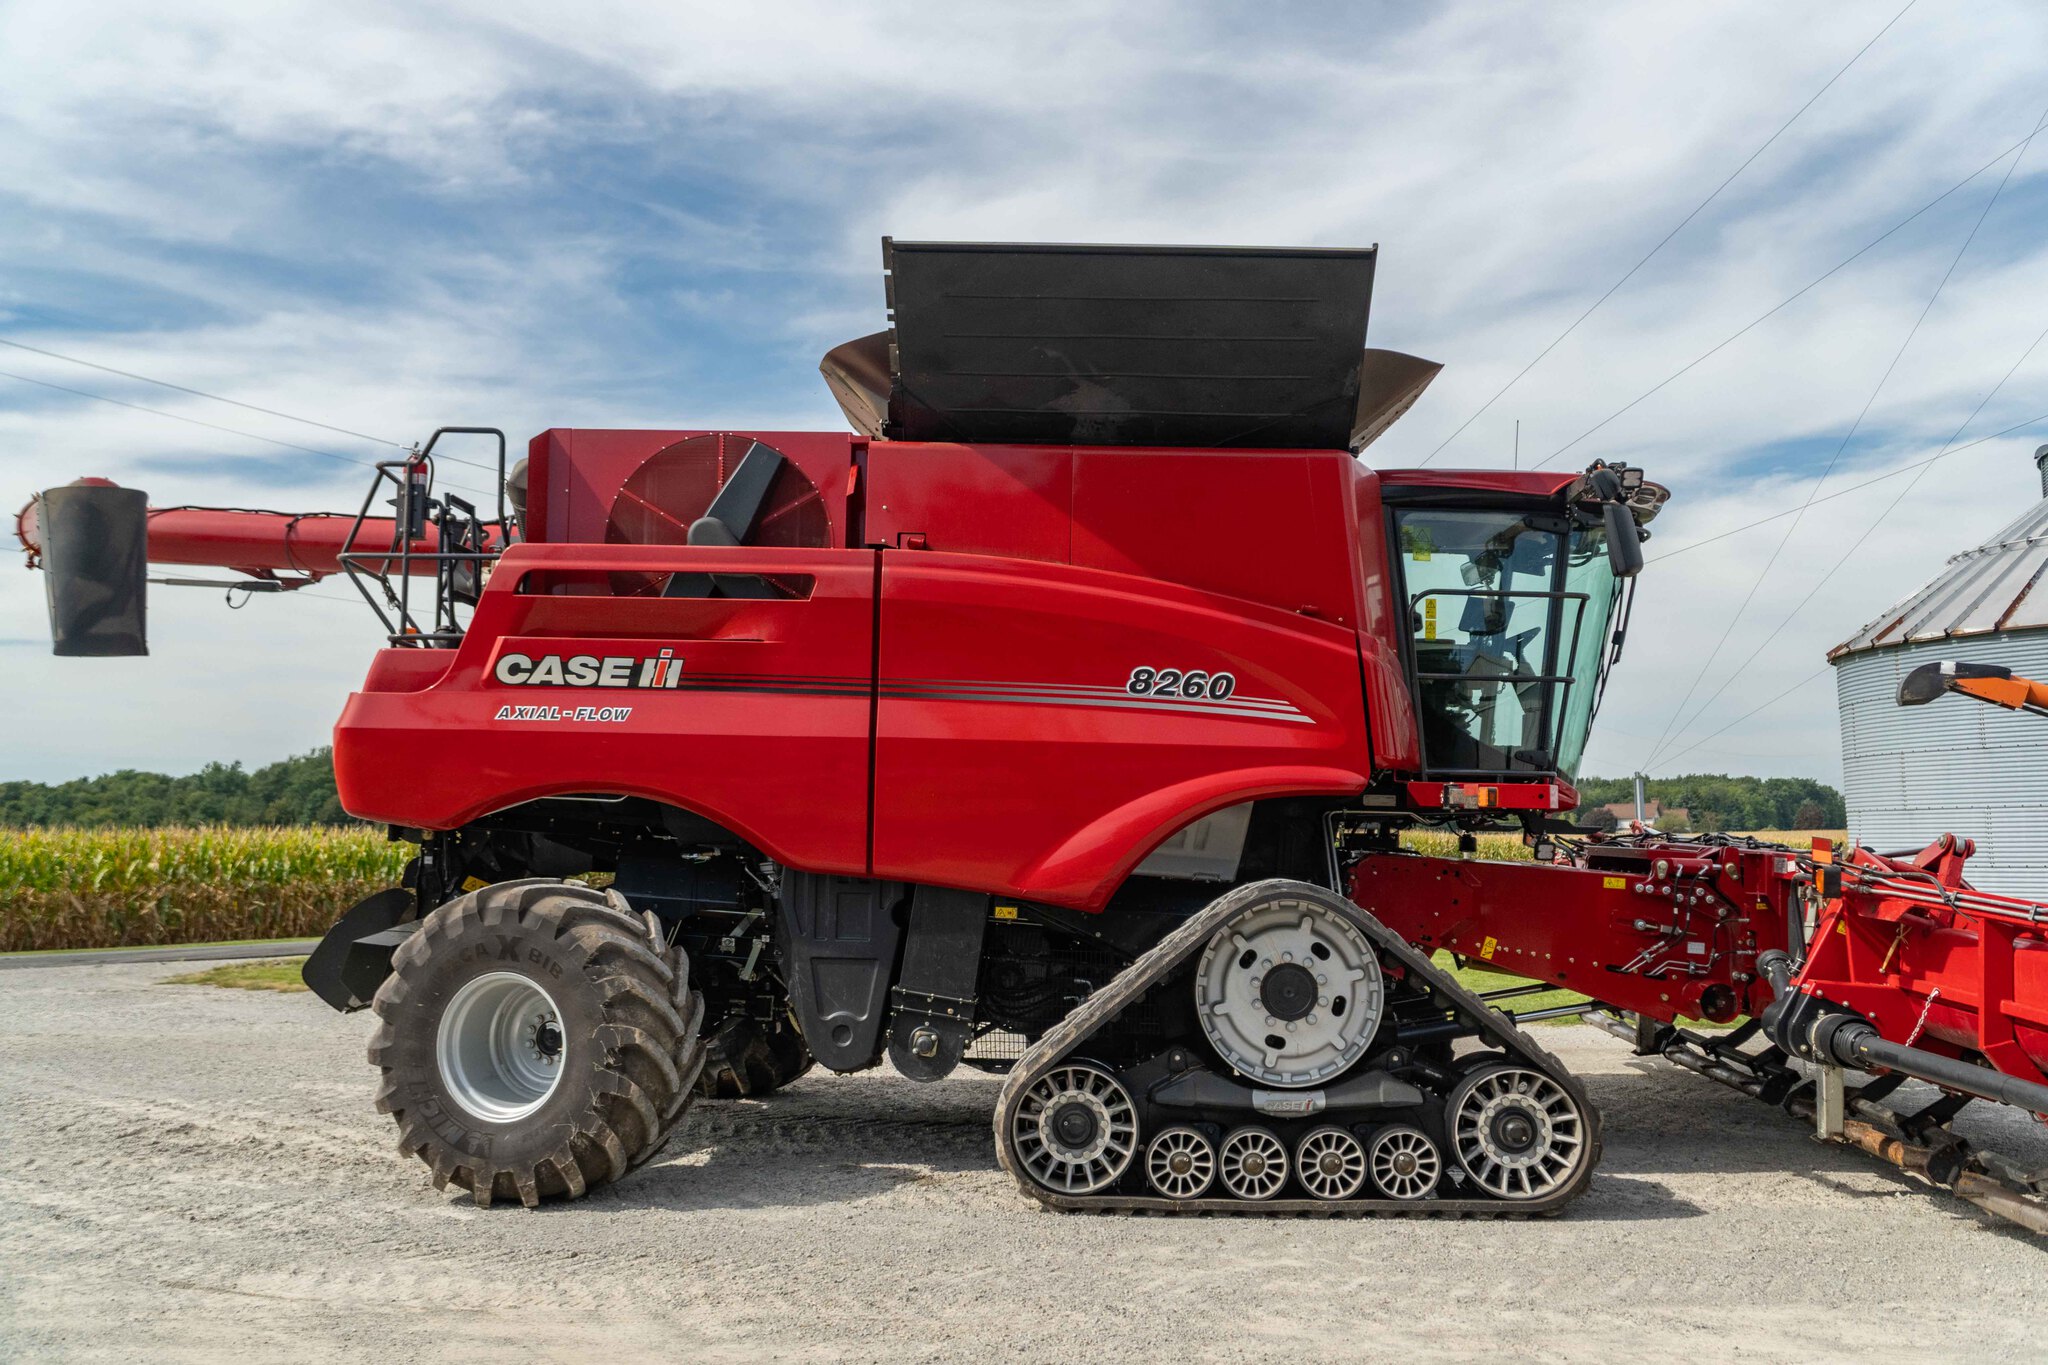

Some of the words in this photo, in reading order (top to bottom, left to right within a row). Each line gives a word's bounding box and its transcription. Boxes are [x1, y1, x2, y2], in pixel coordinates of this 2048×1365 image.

[495, 653, 636, 688] CASE
[1126, 666, 1236, 701] 8260
[495, 706, 633, 721] AXIAL-FLOW
[496, 935, 523, 962] X
[528, 947, 564, 980] BIB
[1264, 1099, 1300, 1112] CASE
